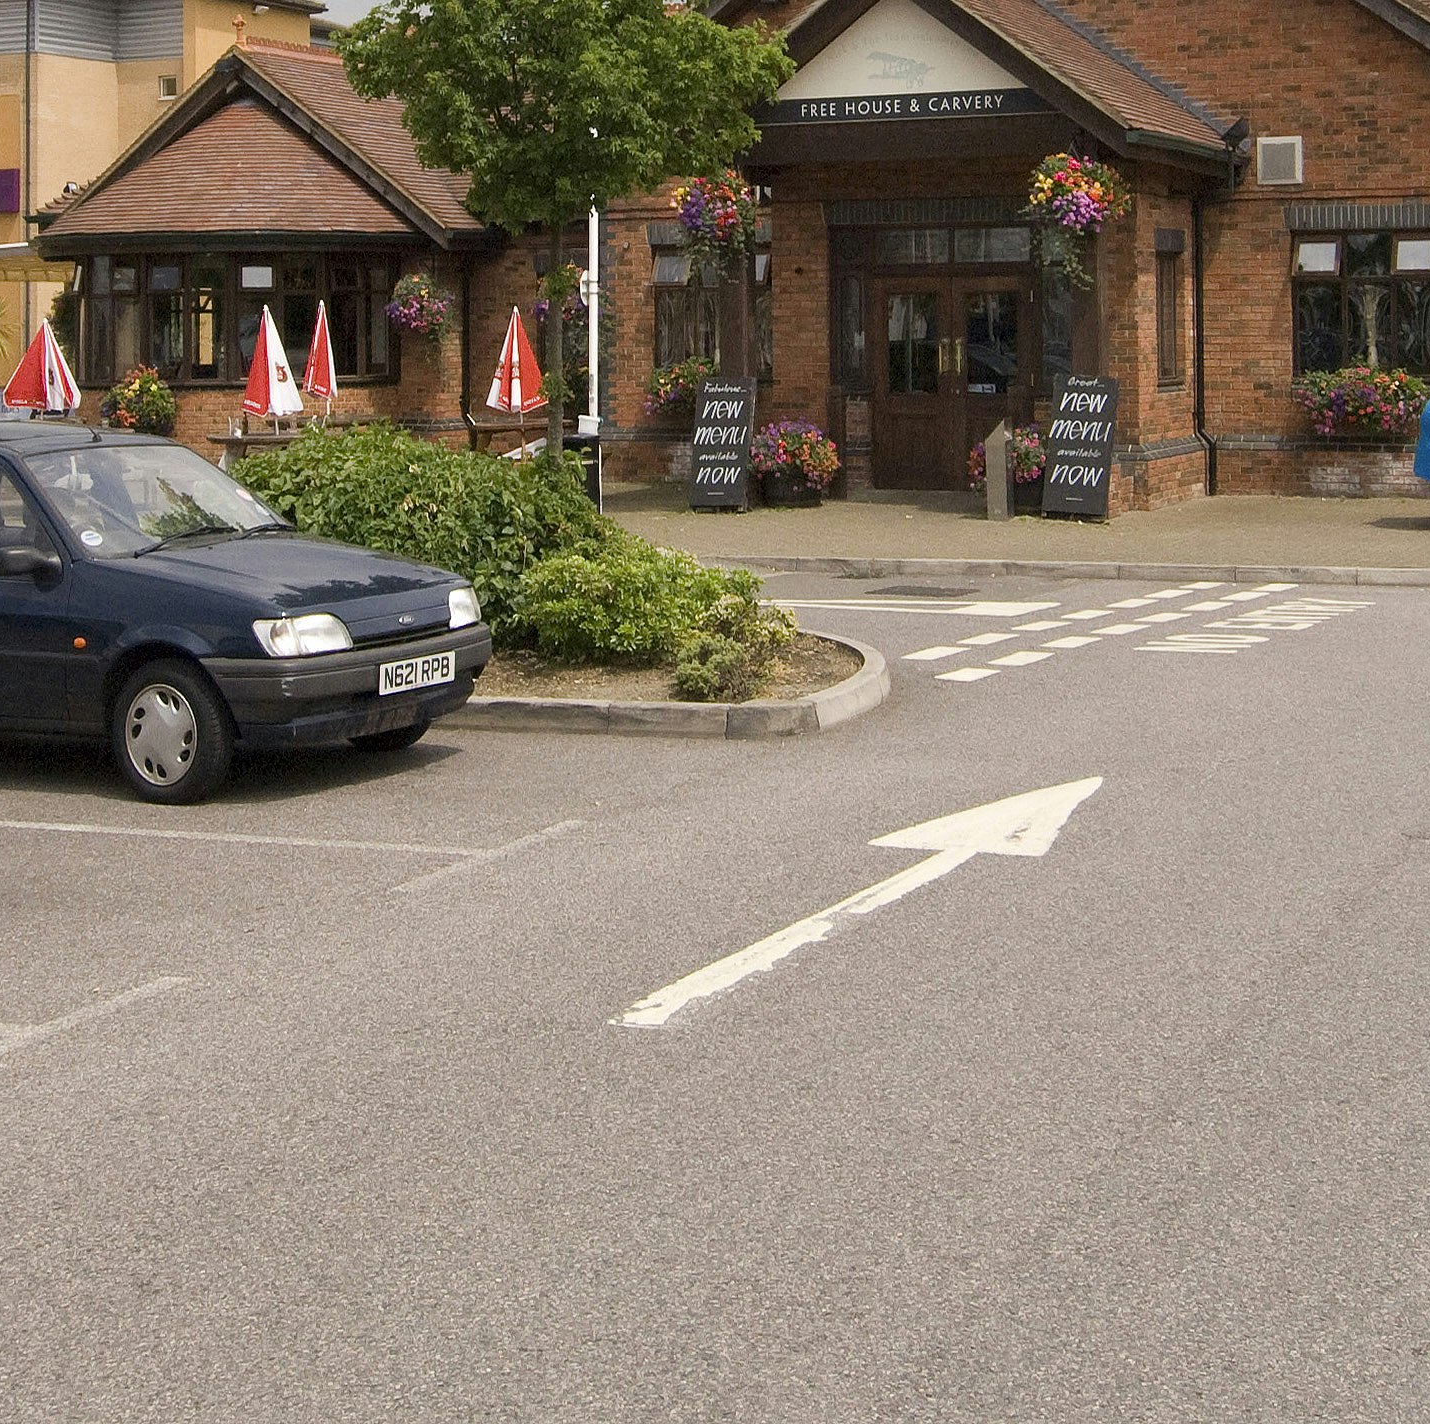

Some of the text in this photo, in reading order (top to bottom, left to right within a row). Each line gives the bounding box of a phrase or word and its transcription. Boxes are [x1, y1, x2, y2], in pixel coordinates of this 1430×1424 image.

[801, 95, 1004, 118] FREE HOUSE & CARVERY
[702, 400, 744, 419] new
[1059, 392, 1108, 413] new
[693, 426, 747, 445] menu
[1049, 419, 1111, 442] menu
[696, 467, 741, 485] now
[1050, 464, 1103, 487] now
[384, 656, 450, 690] N621 RPB
